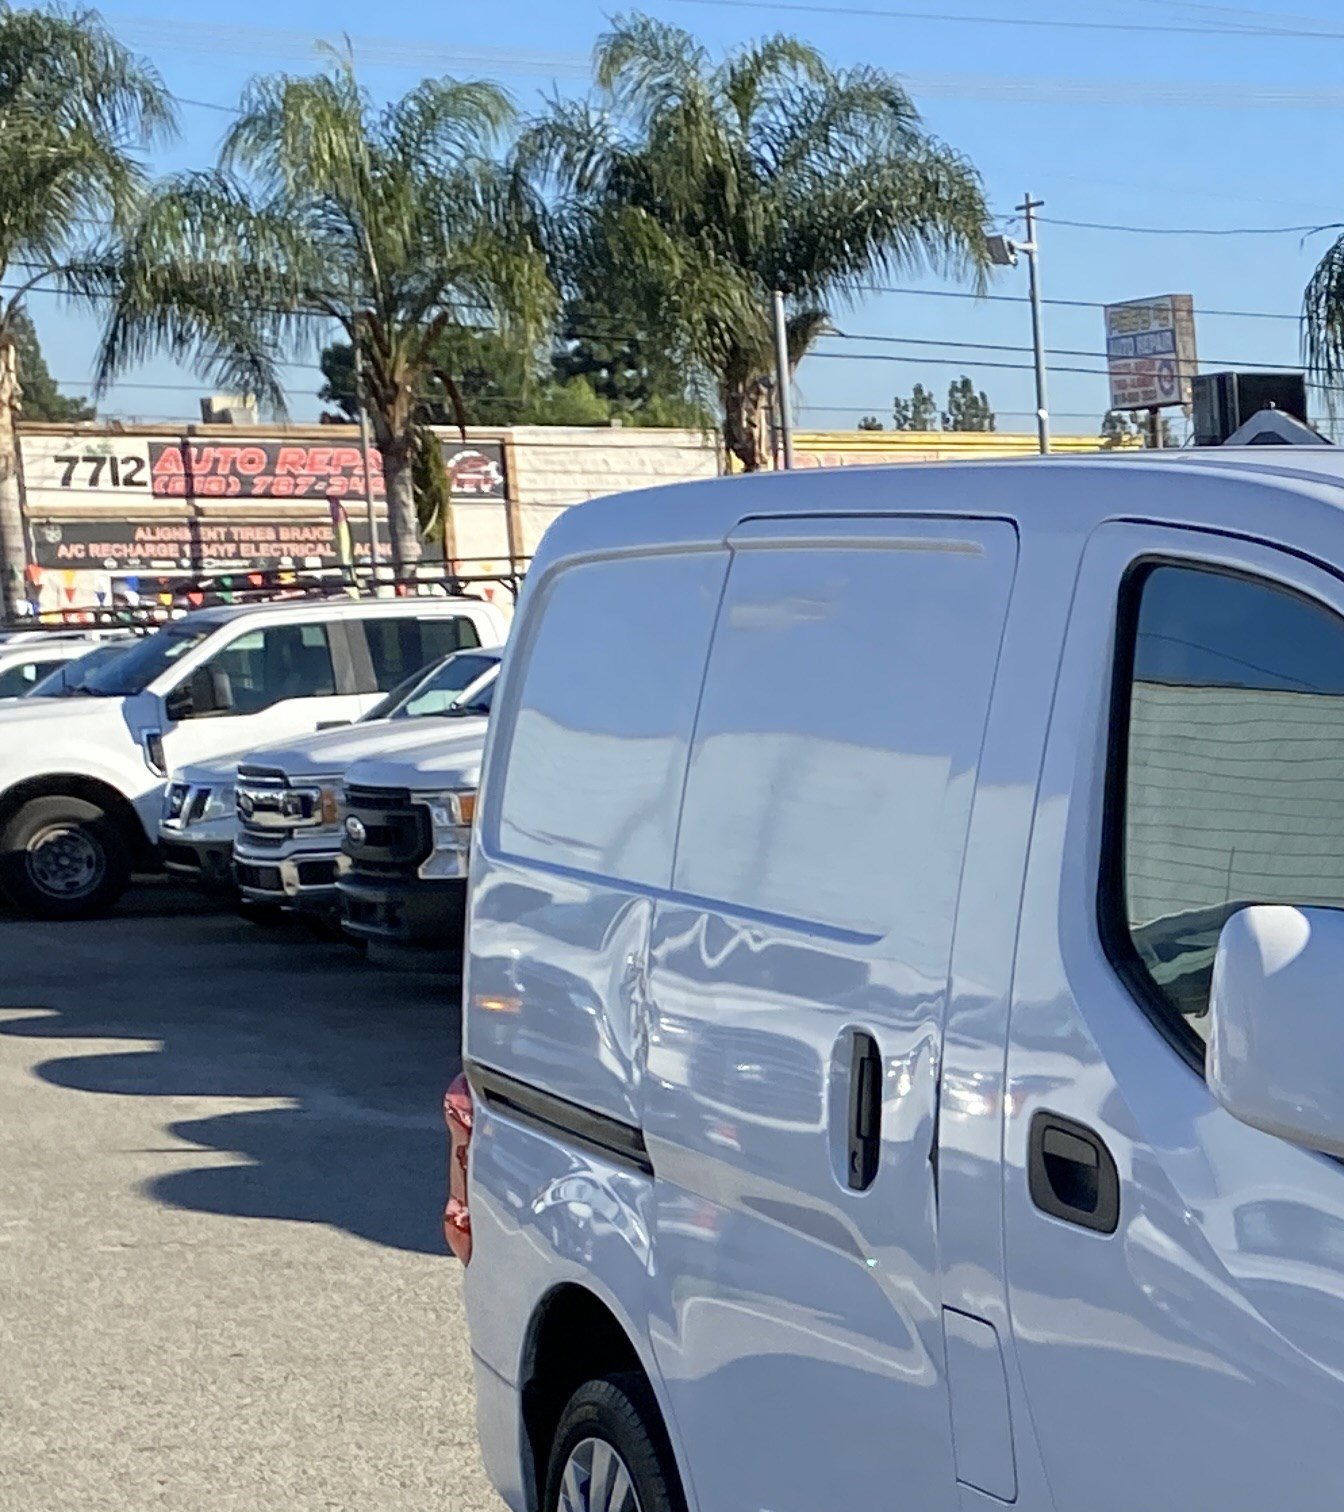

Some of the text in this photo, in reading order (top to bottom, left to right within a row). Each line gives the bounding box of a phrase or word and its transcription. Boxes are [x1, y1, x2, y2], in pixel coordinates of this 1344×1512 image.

[53, 455, 148, 487] 7712
[152, 447, 384, 475] AUTO REPA
[232, 526, 276, 540] TIRES
[57, 543, 86, 559] A/C
[88, 543, 179, 558] RECHARGE
[240, 543, 336, 557] ELECTRICAL
